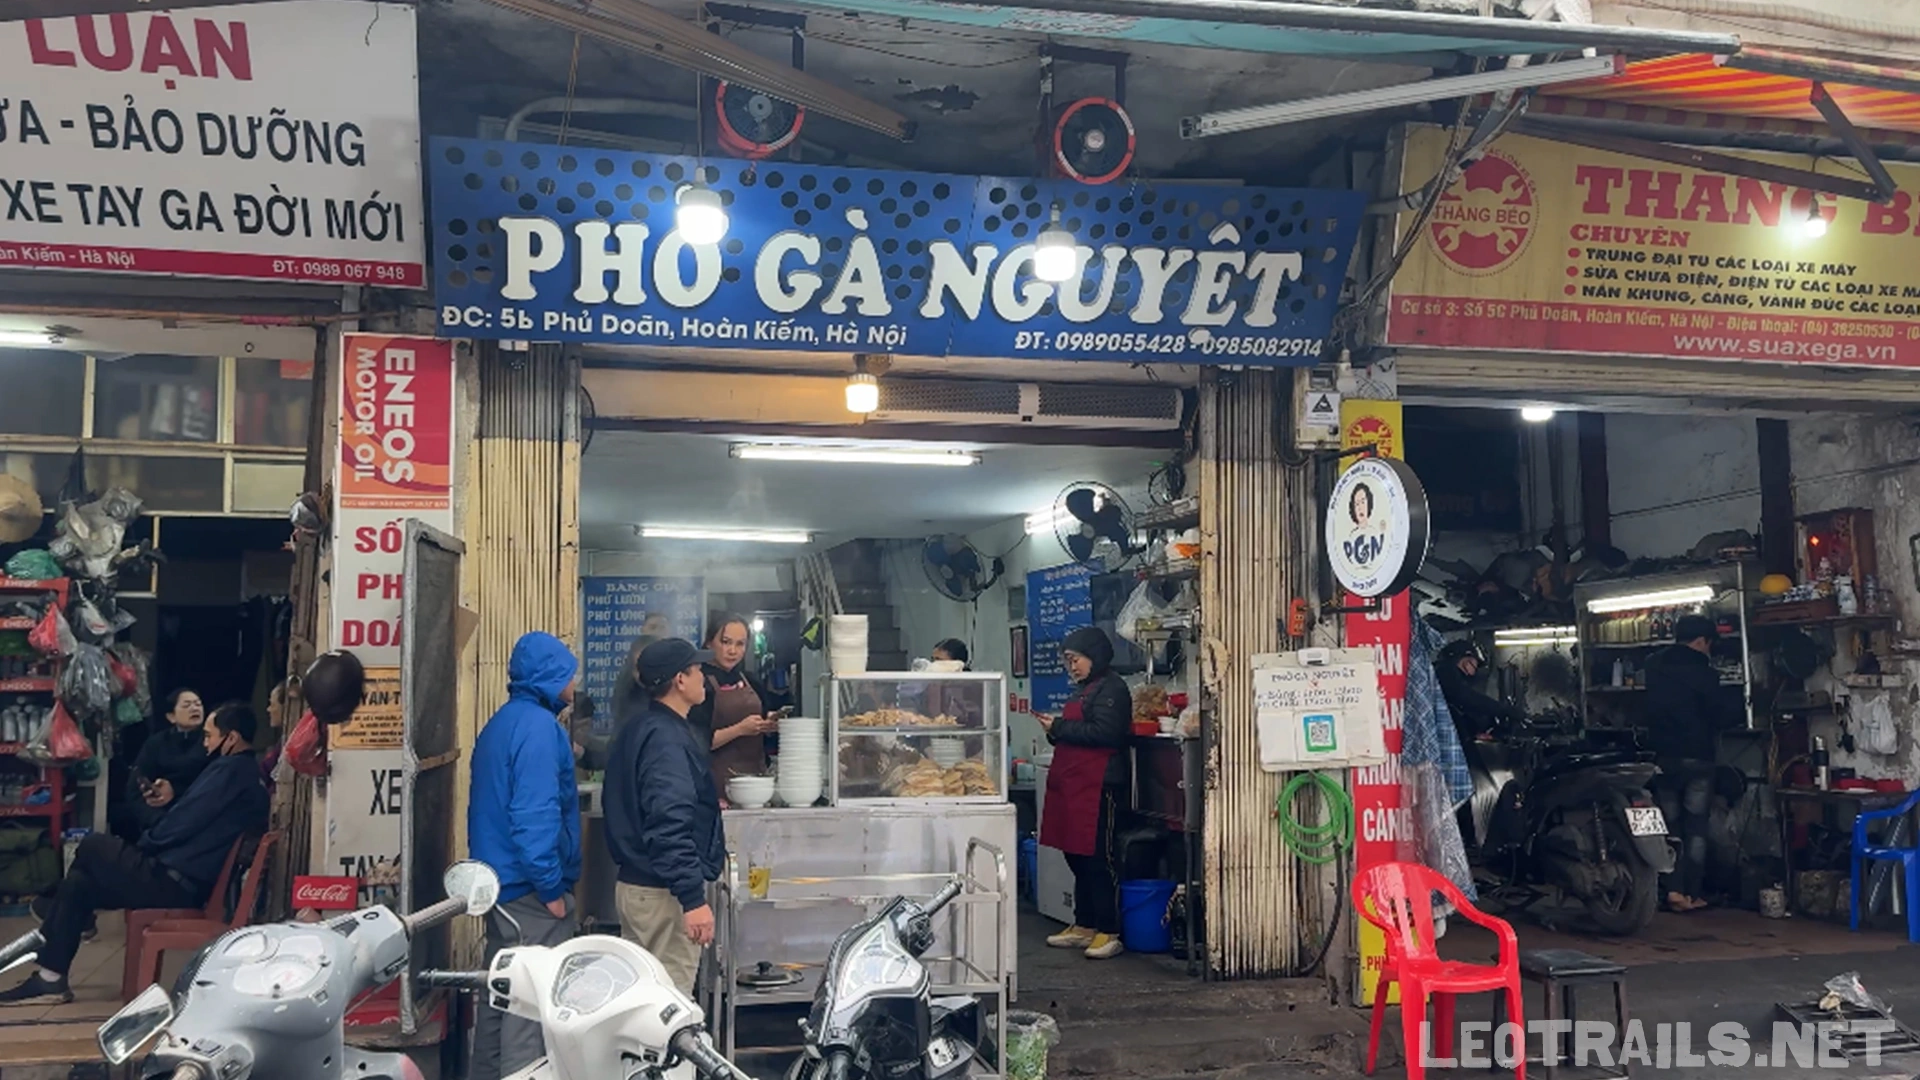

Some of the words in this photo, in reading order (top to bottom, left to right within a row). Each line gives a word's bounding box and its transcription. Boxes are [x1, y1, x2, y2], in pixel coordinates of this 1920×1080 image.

[86, 94, 185, 154] BẢO
[197, 108, 366, 167] DƯỠNG
[0, 179, 64, 224] XE
[67, 184, 144, 228] TAY
[160, 187, 224, 233] GA
[234, 184, 313, 239] ĐỜI
[325, 190, 405, 243] MỚI
[1495, 205, 1531, 226] BÉO
[1861, 190, 1920, 237] B
[1570, 224, 1691, 248] CHUYÊN
[21, 246, 66, 262] Kiếm
[79, 248, 104, 265] Hà
[105, 250, 136, 270] Nội
[272, 260, 300, 276] ĐT:
[303, 262, 341, 278] 0989
[344, 264, 373, 280] 067
[376, 265, 406, 282] 948
[754, 206, 892, 317] GÀ
[919, 222, 1303, 345] NGUYỆT
[1586, 248, 1647, 264] TRUNG
[1652, 252, 1683, 268] ĐẠI
[1688, 255, 1710, 267] TU
[1715, 255, 1746, 270] CÁC
[1752, 258, 1791, 275] LOẠI
[1795, 261, 1816, 274] XE
[1819, 262, 1858, 277] MÁY
[1583, 264, 1618, 280] SỬA
[1676, 272, 1724, 289] ĐIỆN,
[1728, 275, 1770, 291] ĐIỆN
[1836, 282, 1875, 299] LOẠI
[1878, 285, 1899, 297] XE
[1626, 288, 1697, 305] KHUNG,
[1701, 290, 1755, 309] CÀNG,
[1759, 293, 1807, 309] VÀNH
[441, 305, 493, 329] ĐC:
[500, 308, 535, 330] 5b
[543, 309, 594, 334] Phủ
[601, 313, 676, 340] Doãn,
[682, 317, 749, 340] Hoàn
[753, 317, 820, 346] Kiếm,
[825, 322, 859, 345] Hà
[867, 324, 908, 352] Nội
[1445, 302, 1460, 317] 3:
[1463, 300, 1485, 317] Số
[1510, 303, 1538, 320] Phủ
[1586, 308, 1622, 324] Hoàn
[1626, 309, 1665, 328] Kiếm,
[1669, 312, 1688, 327] Hà
[1691, 313, 1715, 331] Nội
[1726, 315, 1757, 335] Điện
[1761, 318, 1799, 336] thoại:
[1802, 320, 1828, 337] (04)
[1014, 331, 1051, 350] ĐT:
[1055, 332, 1186, 354] 0989055428
[1201, 337, 1324, 357] 0985082914
[1673, 334, 1897, 362] www.suaxega.vn
[354, 347, 378, 436] MOTOR
[381, 348, 416, 484] ENEOS
[353, 443, 376, 483] OIL
[354, 517, 404, 554] SỐ
[1358, 636, 1403, 676] ÀN
[1363, 799, 1414, 842] CÀNG
